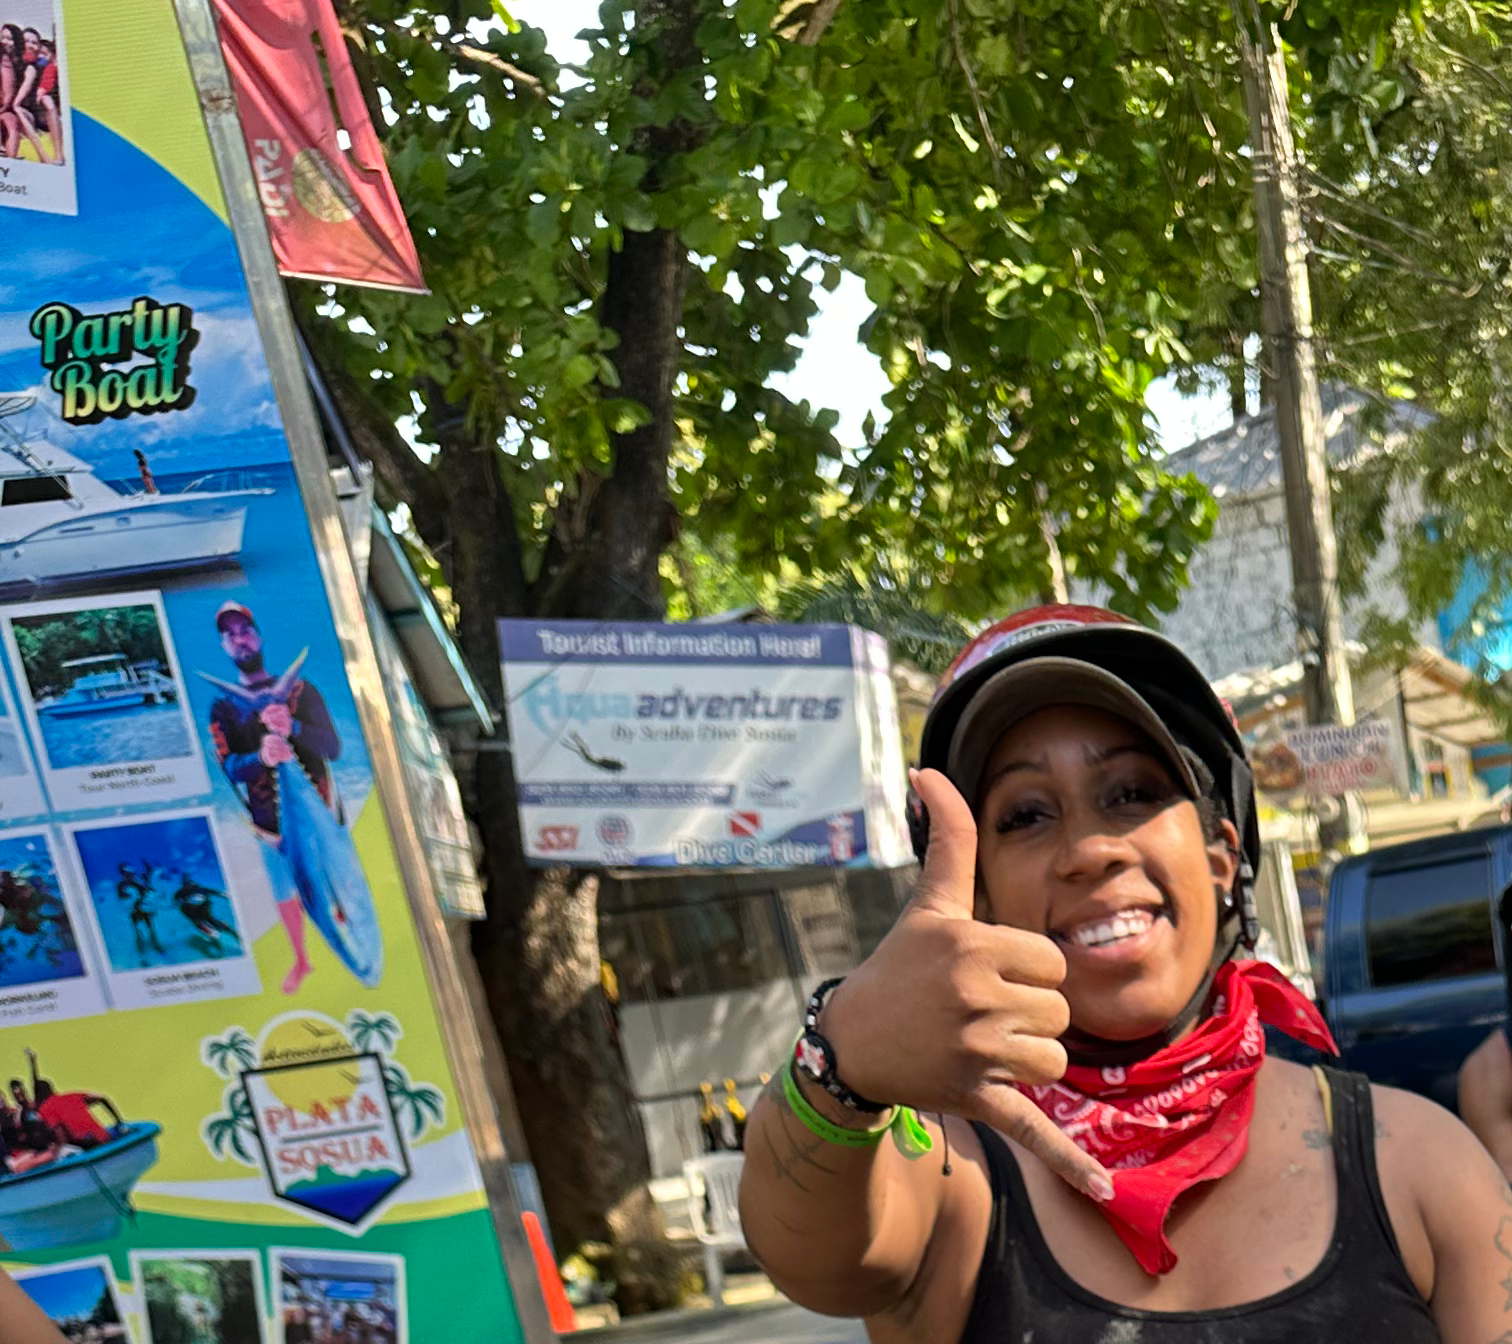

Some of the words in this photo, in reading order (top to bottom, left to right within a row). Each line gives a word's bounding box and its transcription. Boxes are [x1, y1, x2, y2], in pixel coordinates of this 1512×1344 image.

[31, 298, 192, 366] Party
[52, 360, 188, 420] Boat
[536, 629, 620, 656] Tourist
[622, 631, 757, 658] Information
[263, 1093, 382, 1135] PLATA
[277, 1134, 391, 1175] SOSUA
